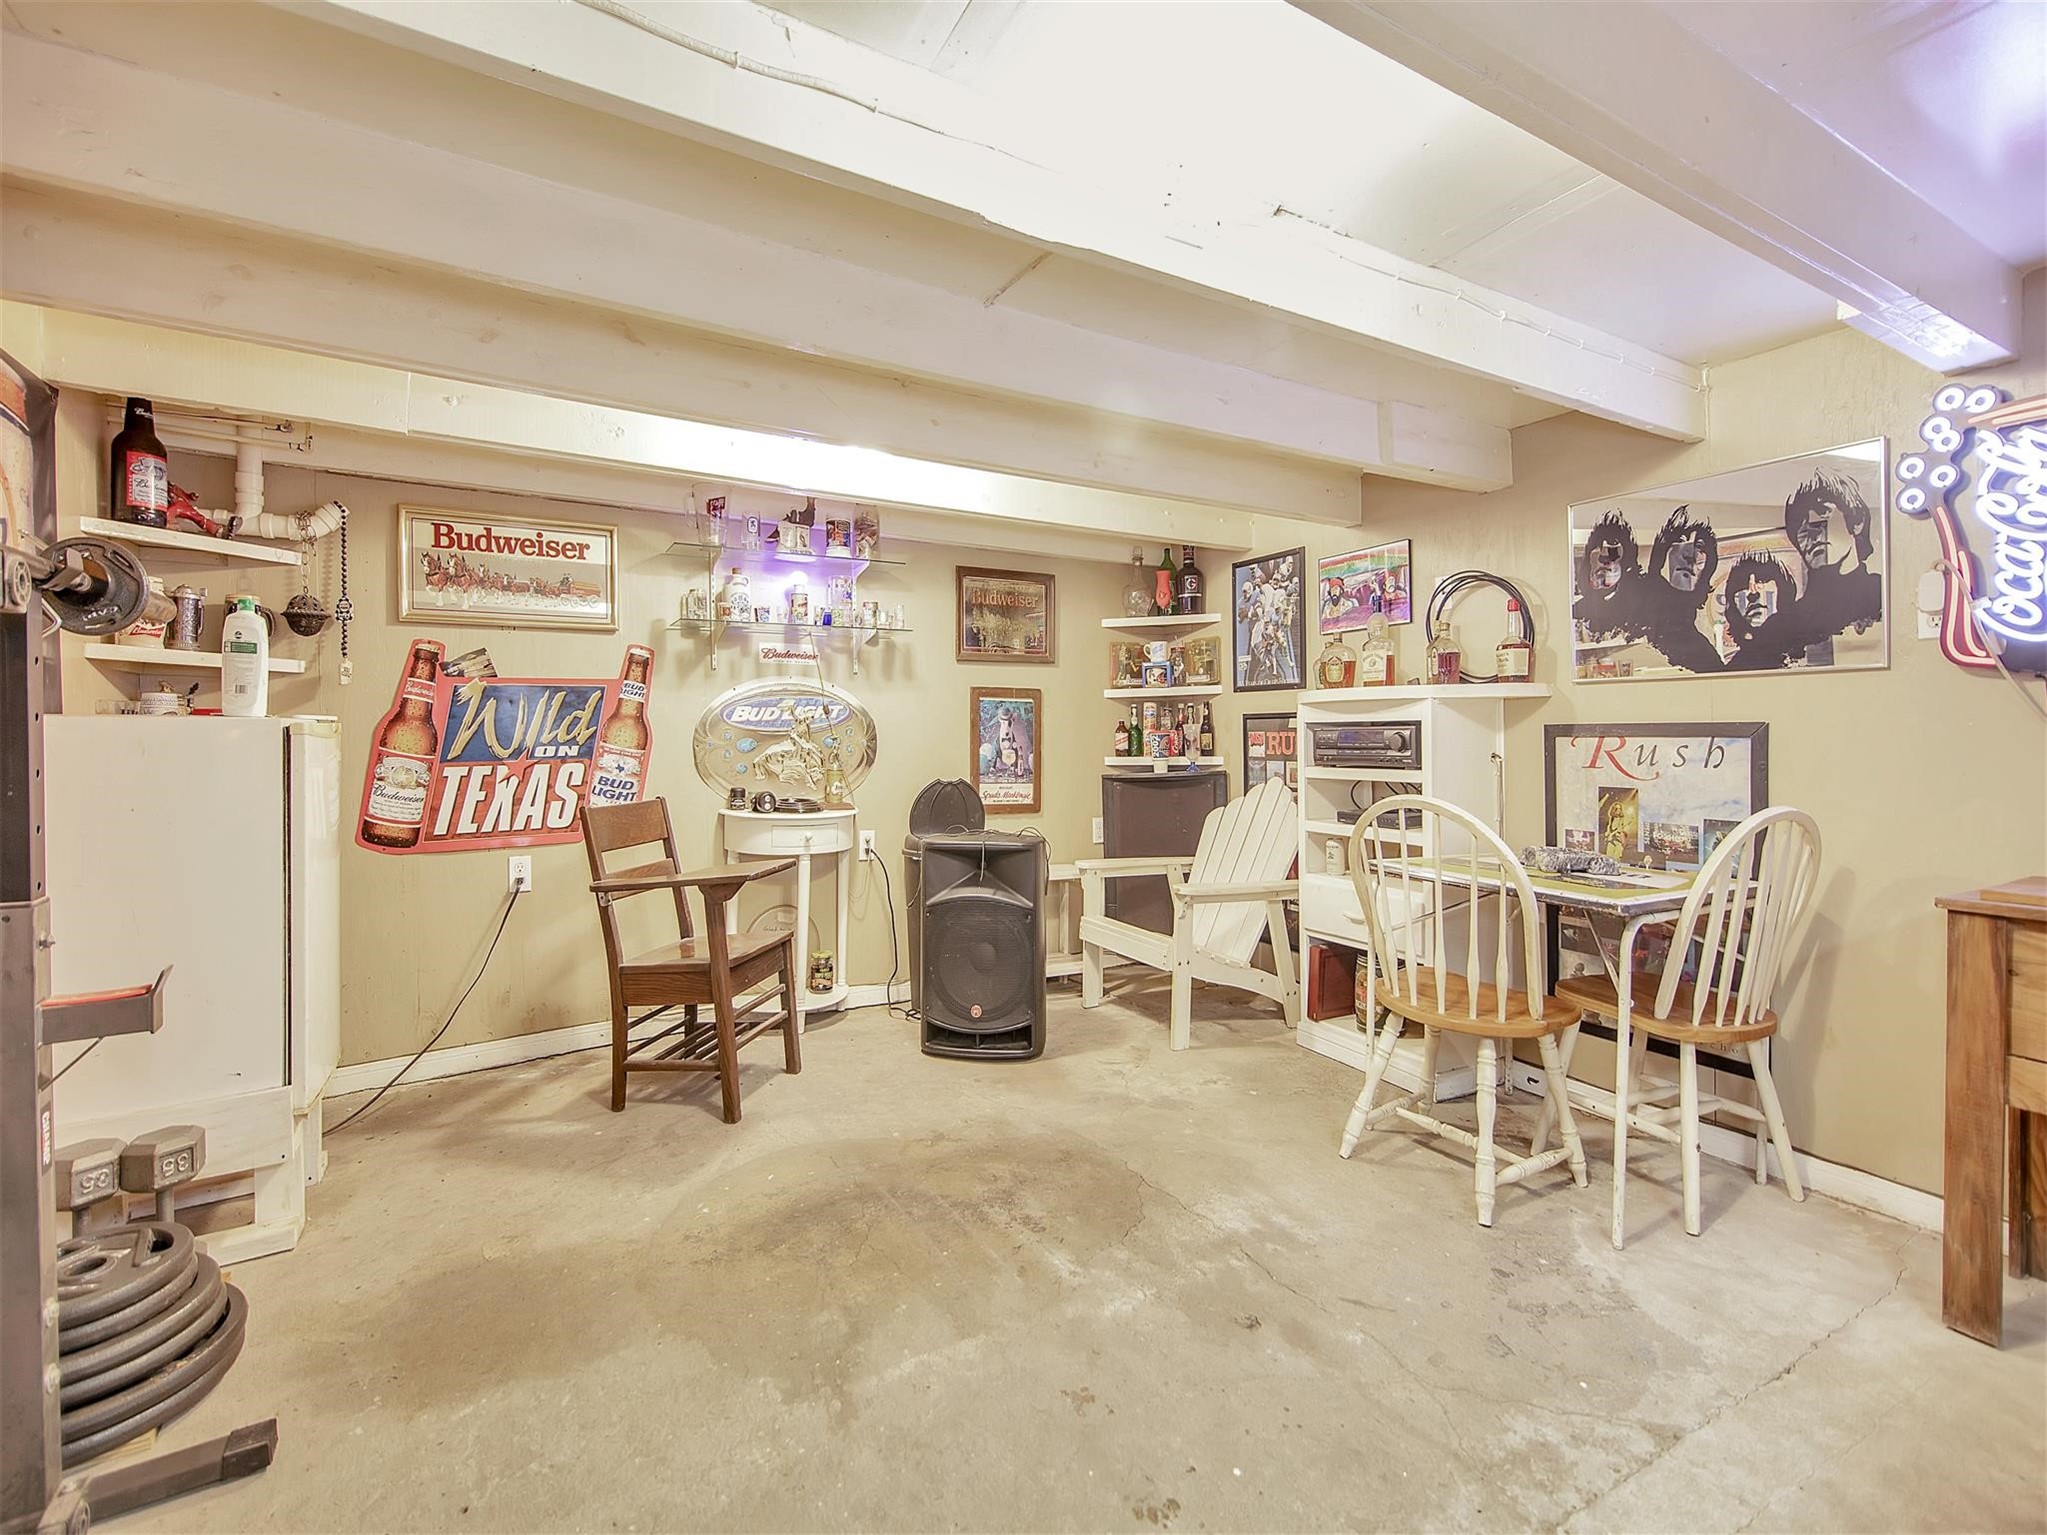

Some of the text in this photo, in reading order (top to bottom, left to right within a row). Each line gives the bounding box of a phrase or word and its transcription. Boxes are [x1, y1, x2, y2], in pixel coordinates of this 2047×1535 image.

[431, 522, 590, 560] Budweiser
[971, 587, 1038, 608] Budweiser
[761, 647, 819, 660] Budweiser
[624, 682, 645, 692] BUD
[447, 677, 602, 760] Wild
[731, 705, 780, 721] BUD
[534, 745, 581, 758] ON
[1569, 735, 1726, 782] Rush
[373, 782, 425, 803] Budweiser
[592, 785, 637, 801] LIGHT
[598, 775, 635, 790] BUD
[433, 763, 586, 836] TEXAS
[41, 1111, 51, 1166] CHAMP
[162, 1153, 189, 1177] 35
[80, 1168, 110, 1194] 35
